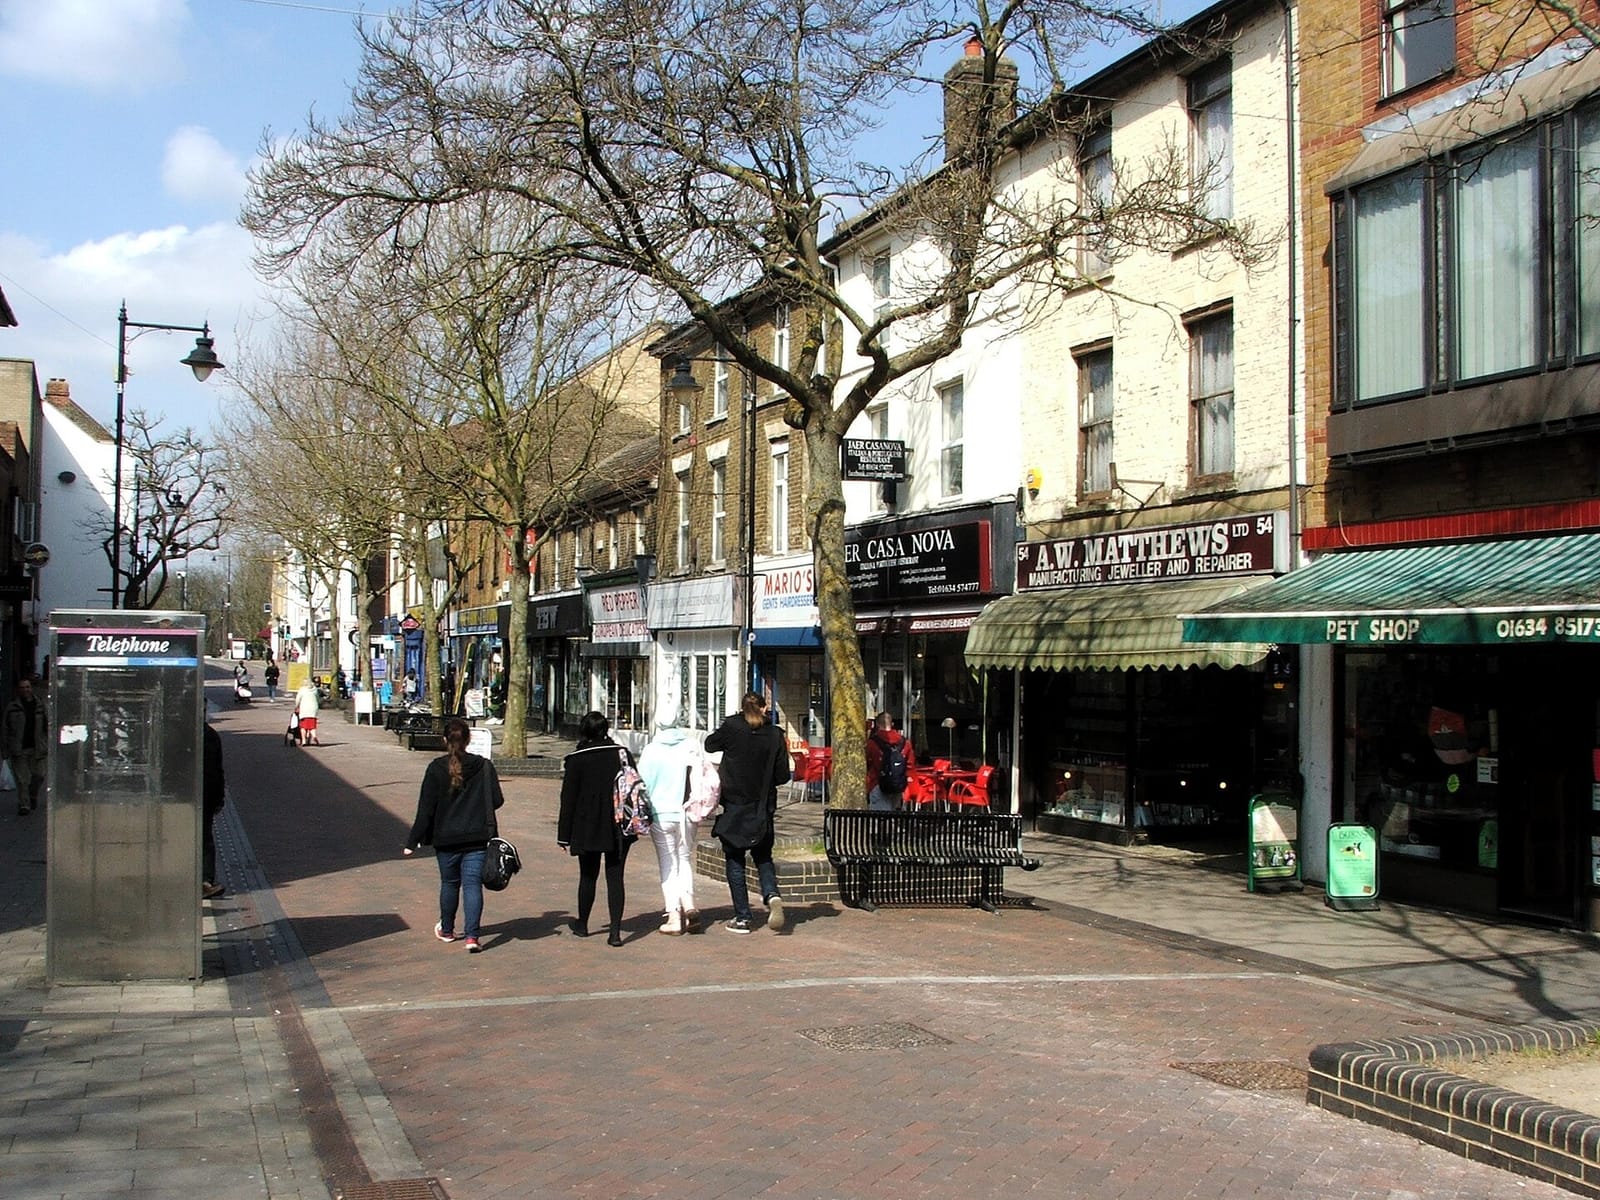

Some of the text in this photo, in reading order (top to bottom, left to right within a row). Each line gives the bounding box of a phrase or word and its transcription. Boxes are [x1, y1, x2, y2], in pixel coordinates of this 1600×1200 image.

[847, 441, 902, 451] JAER CASANOVA
[1256, 516, 1273, 535] 54
[867, 538, 905, 560] CASA
[911, 529, 955, 554] NOVA
[1018, 546, 1029, 561] 54
[1083, 522, 1229, 567] MATTHEWS
[1232, 523, 1249, 537] LTD
[1028, 552, 1252, 586] MANUFACTURING JEWELLER AND REPAIRER
[764, 569, 812, 596] MARIO'S
[601, 594, 614, 612] RED
[614, 591, 640, 611] PEPPER
[762, 597, 778, 610] GENTS
[1326, 619, 1420, 641] PET SHOP
[1497, 616, 1600, 638] 01634 85173
[87, 635, 170, 655] Telephone
